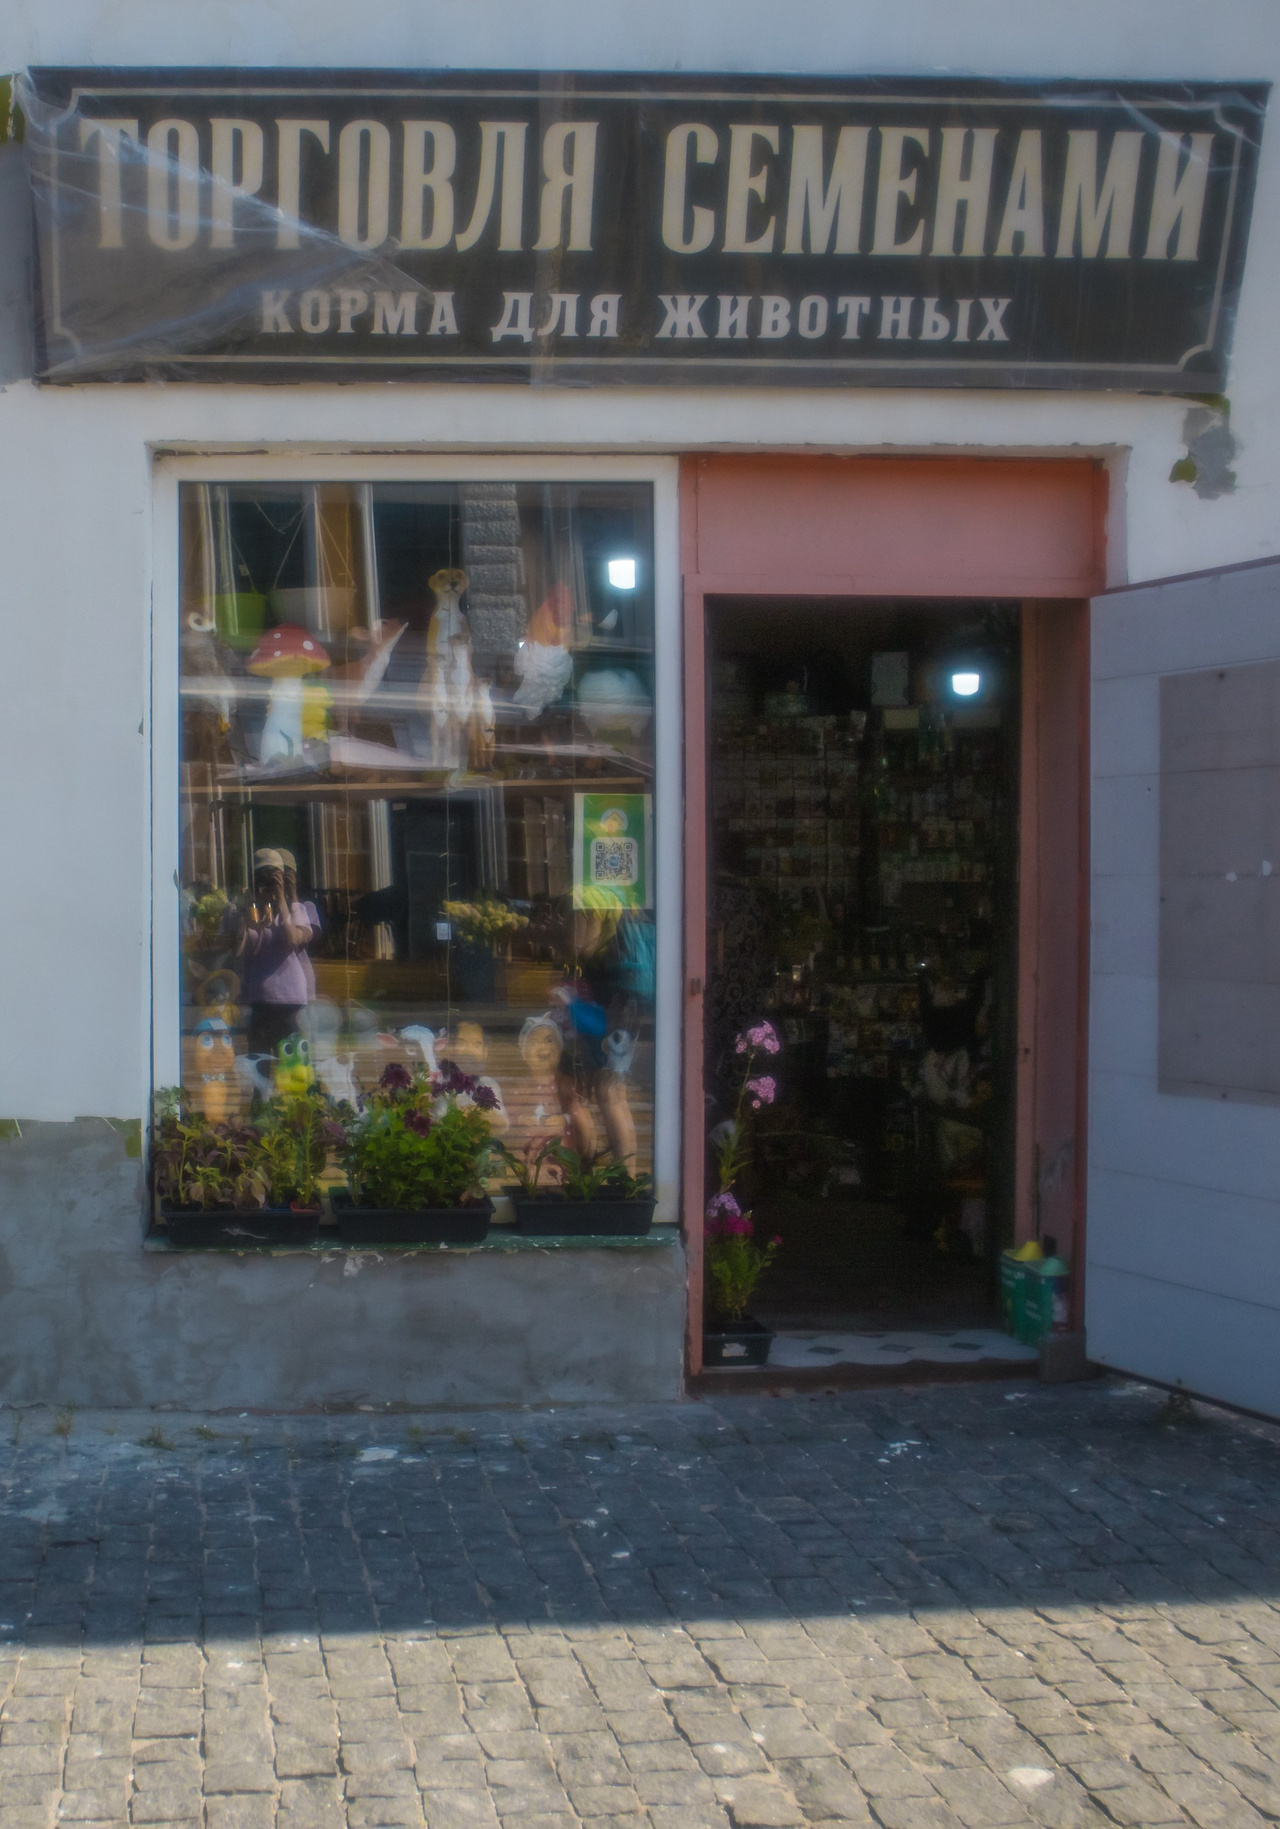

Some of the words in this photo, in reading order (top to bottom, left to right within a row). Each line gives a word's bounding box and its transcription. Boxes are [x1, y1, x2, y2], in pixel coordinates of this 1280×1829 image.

[79, 117, 600, 253] ТОРГОВЛЯ
[661, 122, 1217, 262] СЕМЕНАМИ
[261, 290, 459, 337] КОРМА
[491, 291, 623, 343] ДЛЯ
[655, 294, 1013, 343] ЖИВОТНЫХ
